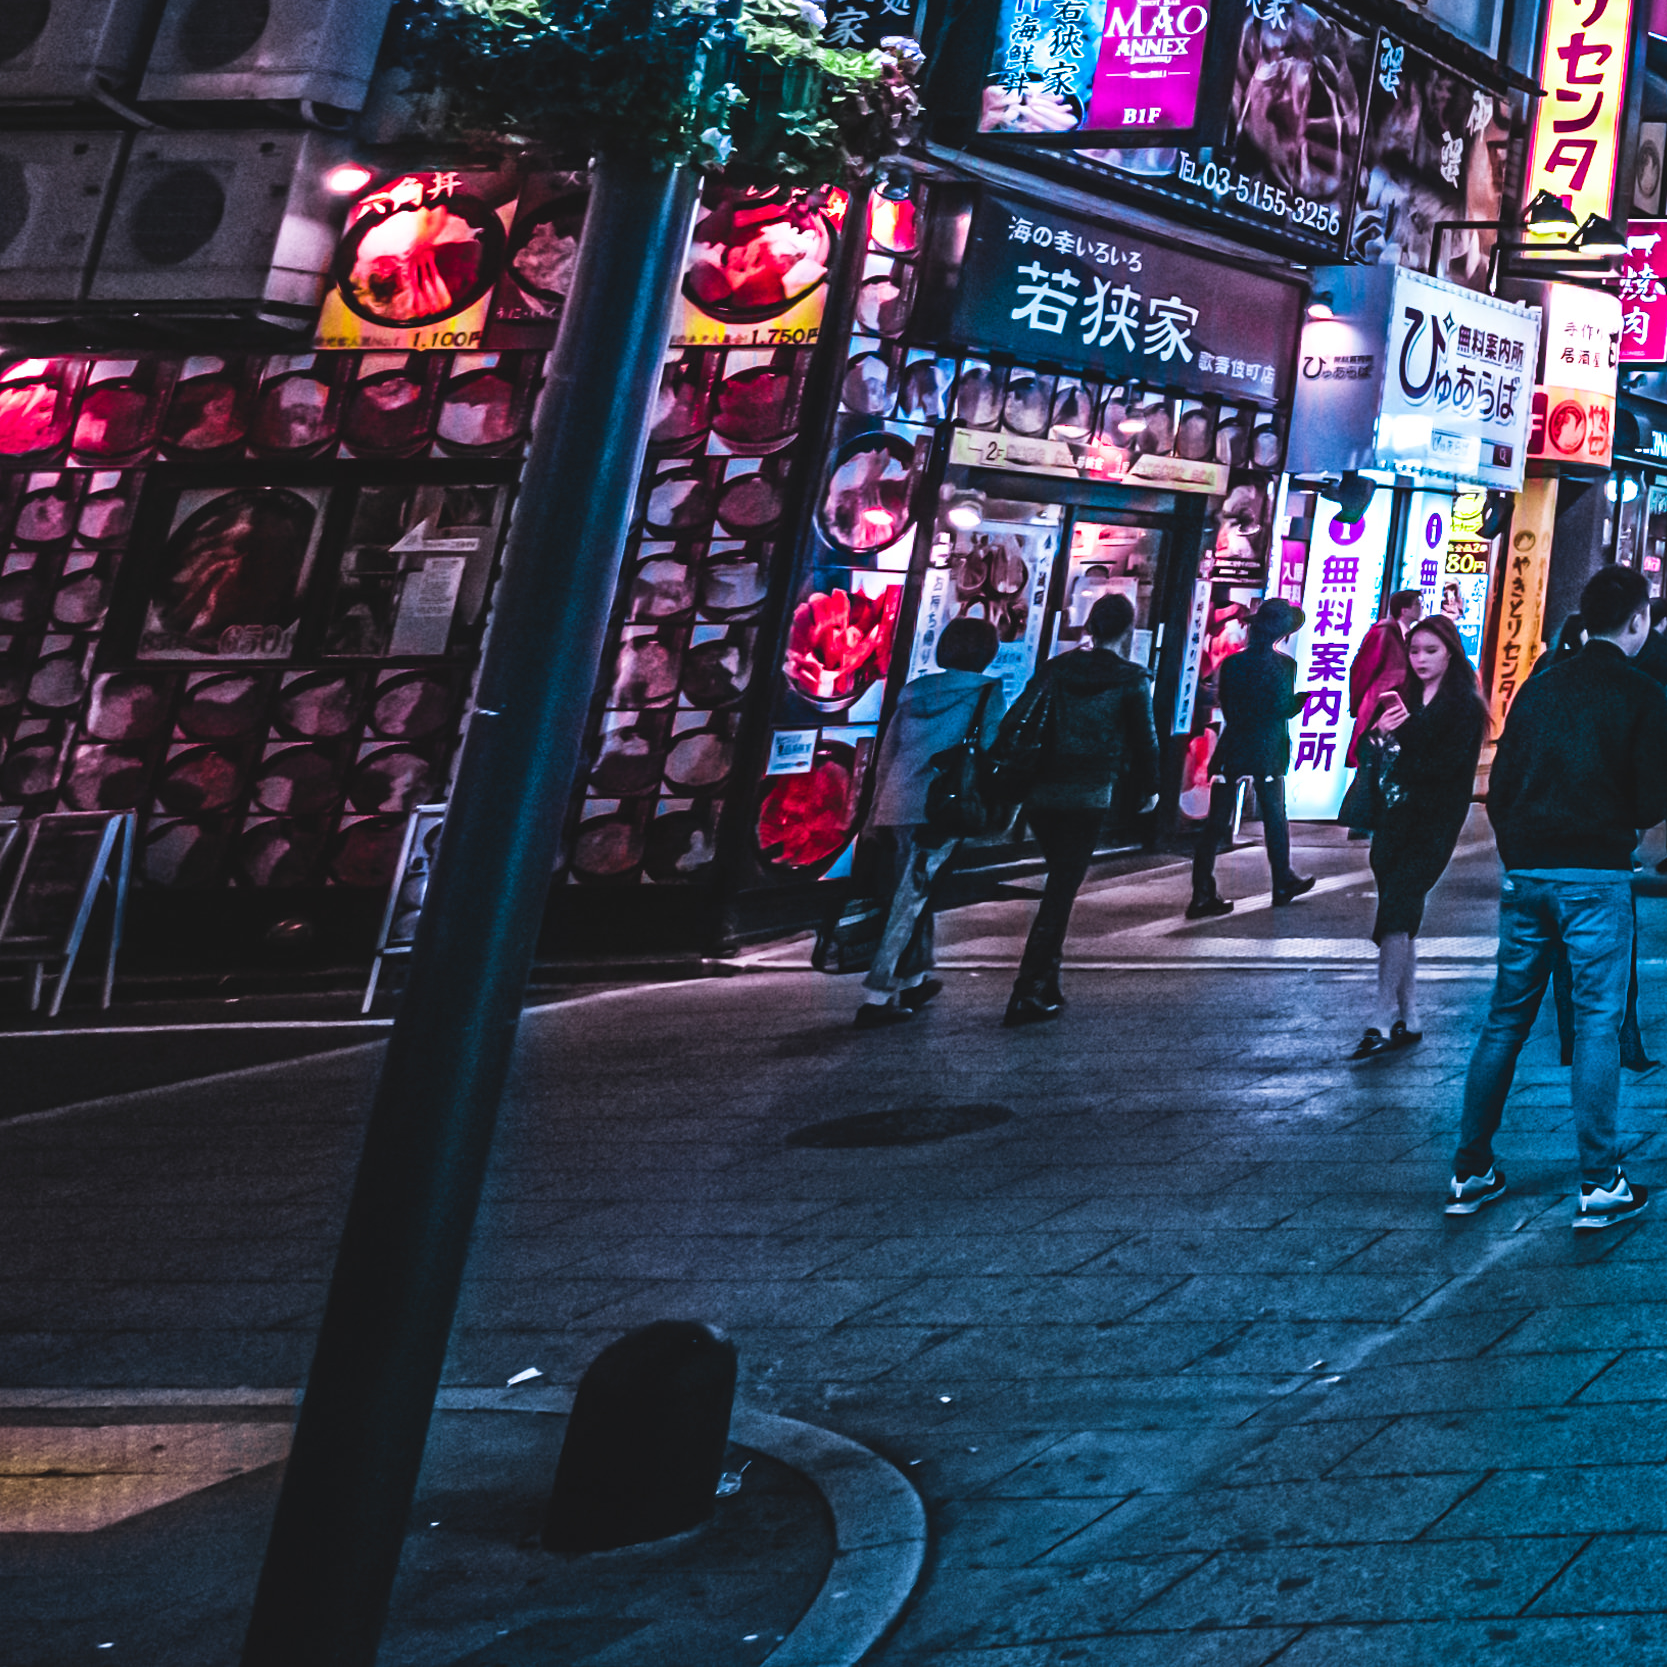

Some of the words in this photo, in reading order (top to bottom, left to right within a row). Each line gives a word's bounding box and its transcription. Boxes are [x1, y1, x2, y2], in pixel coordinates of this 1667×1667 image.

[1002, 15, 1041, 97] 海鮮丼
[1114, 37, 1192, 57] ANNEX
[1121, 107, 1162, 125] B1F
[1007, 214, 1144, 273] 海の幸いろいろ
[1011, 260, 1200, 363] 若狭家
[1618, 262, 1666, 346] 焼肉
[1197, 349, 1276, 384] 歌舞伎町店
[1399, 306, 1517, 421] ぴゅあらば
[1456, 323, 1525, 365] 無料案内所
[1293, 553, 1361, 772] 無料案内所
